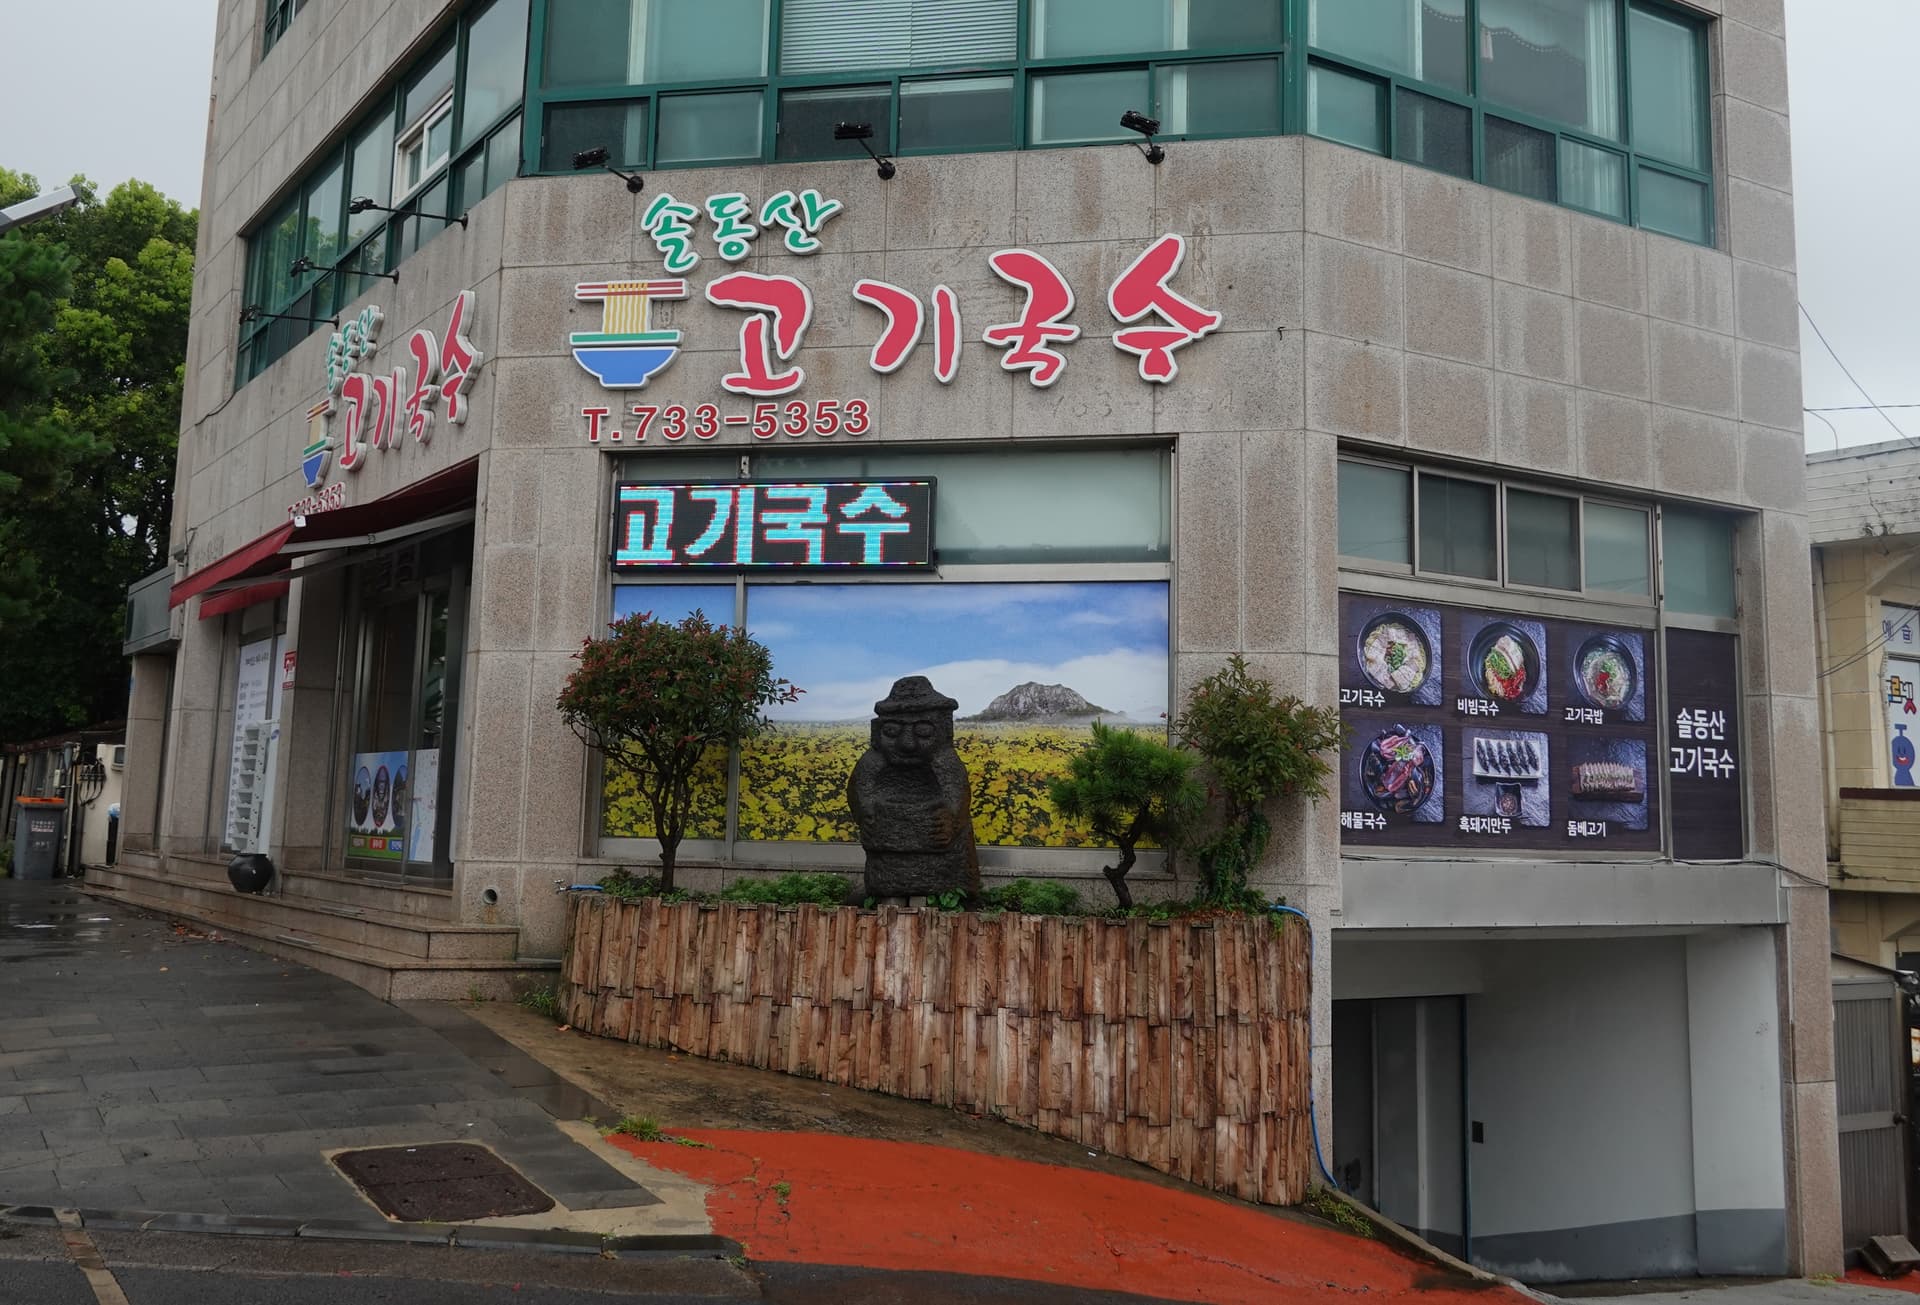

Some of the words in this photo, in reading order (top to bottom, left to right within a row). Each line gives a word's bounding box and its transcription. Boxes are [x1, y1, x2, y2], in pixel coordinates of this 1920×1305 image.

[641, 189, 844, 274] 솔동산
[706, 233, 1222, 396] 고기국수
[326, 305, 383, 393] 솔동산
[339, 290, 480, 471] 고기국수
[617, 487, 911, 566] 고기국수
[1339, 688, 1385, 708] 고기국수
[1457, 698, 1500, 716] 비빔국수
[1564, 707, 1604, 725] 고기국밥
[1675, 708, 1726, 742] 솔동산
[1669, 746, 1735, 779] 고기국수
[1340, 811, 1387, 831] 해물국수
[1459, 815, 1512, 835] 흑돼지만두
[1567, 820, 1606, 838] 돔베고기
